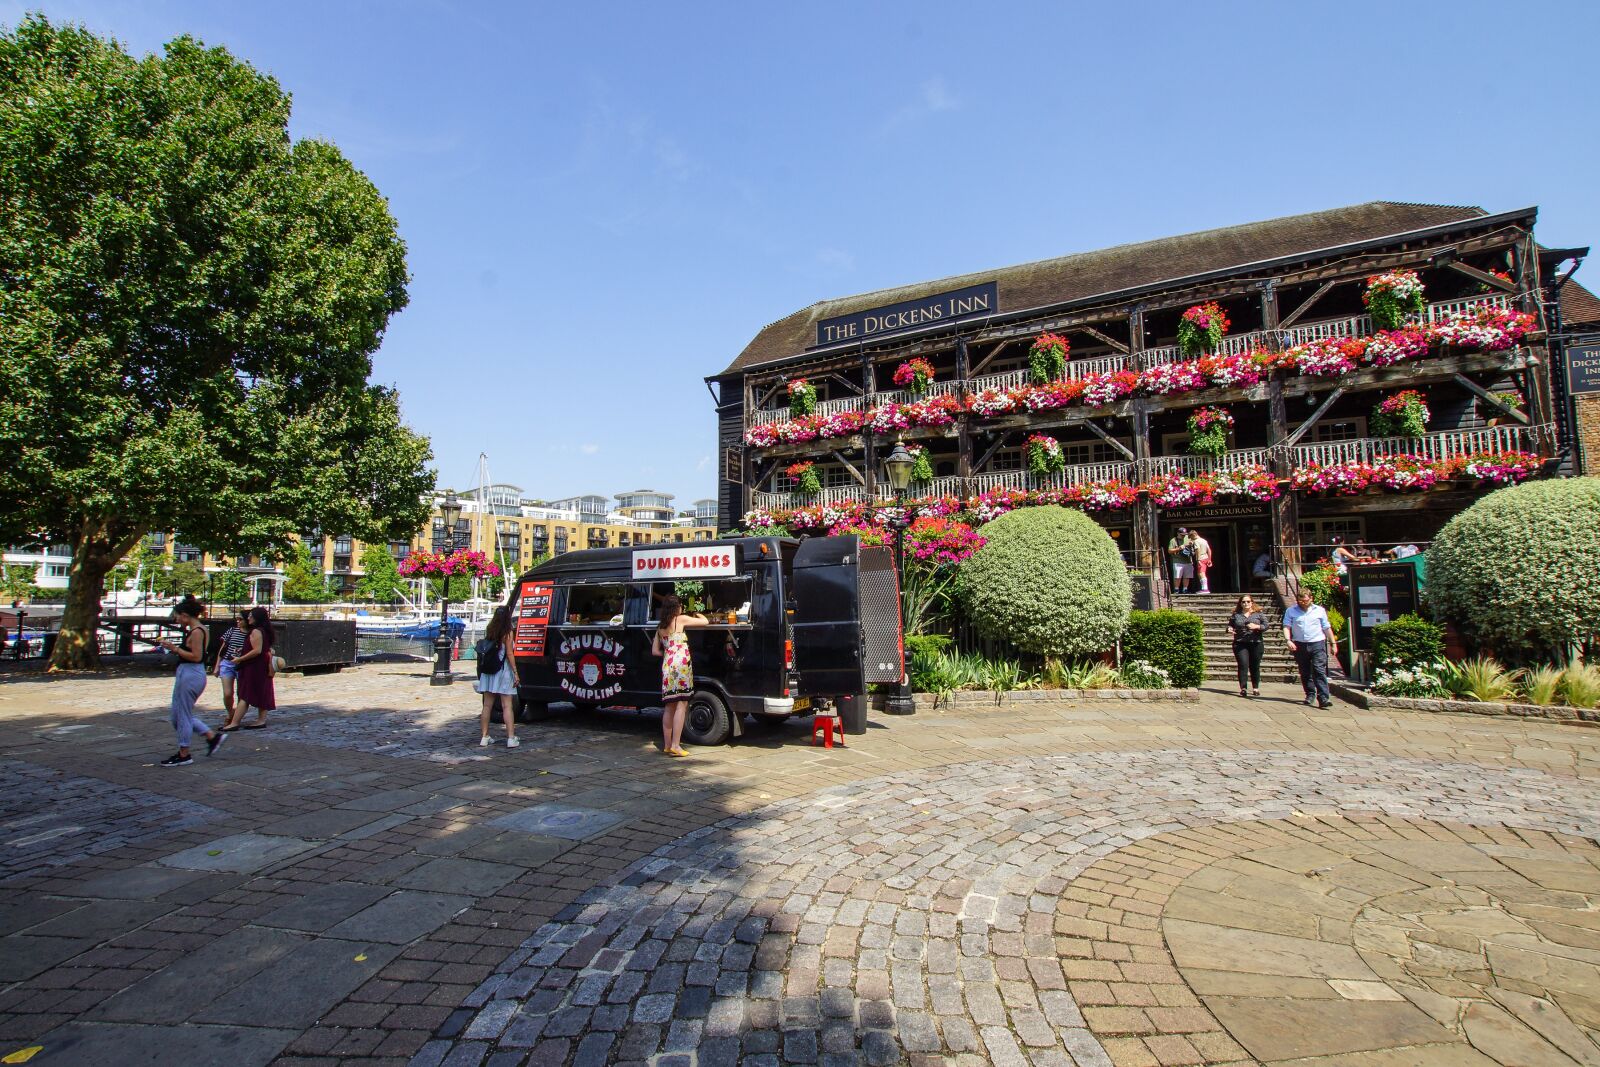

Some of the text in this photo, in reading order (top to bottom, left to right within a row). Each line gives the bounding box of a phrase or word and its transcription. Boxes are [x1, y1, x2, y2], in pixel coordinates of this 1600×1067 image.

[824, 293, 988, 342] THE DICKENS INN
[1572, 359, 1600, 367] DICK
[1184, 509, 1201, 517] AND
[1204, 506, 1262, 516] RESTAURANTS
[636, 554, 731, 571] DUMPLINGS
[560, 634, 624, 657] CHUBBY
[560, 678, 622, 700] DUMPLING
